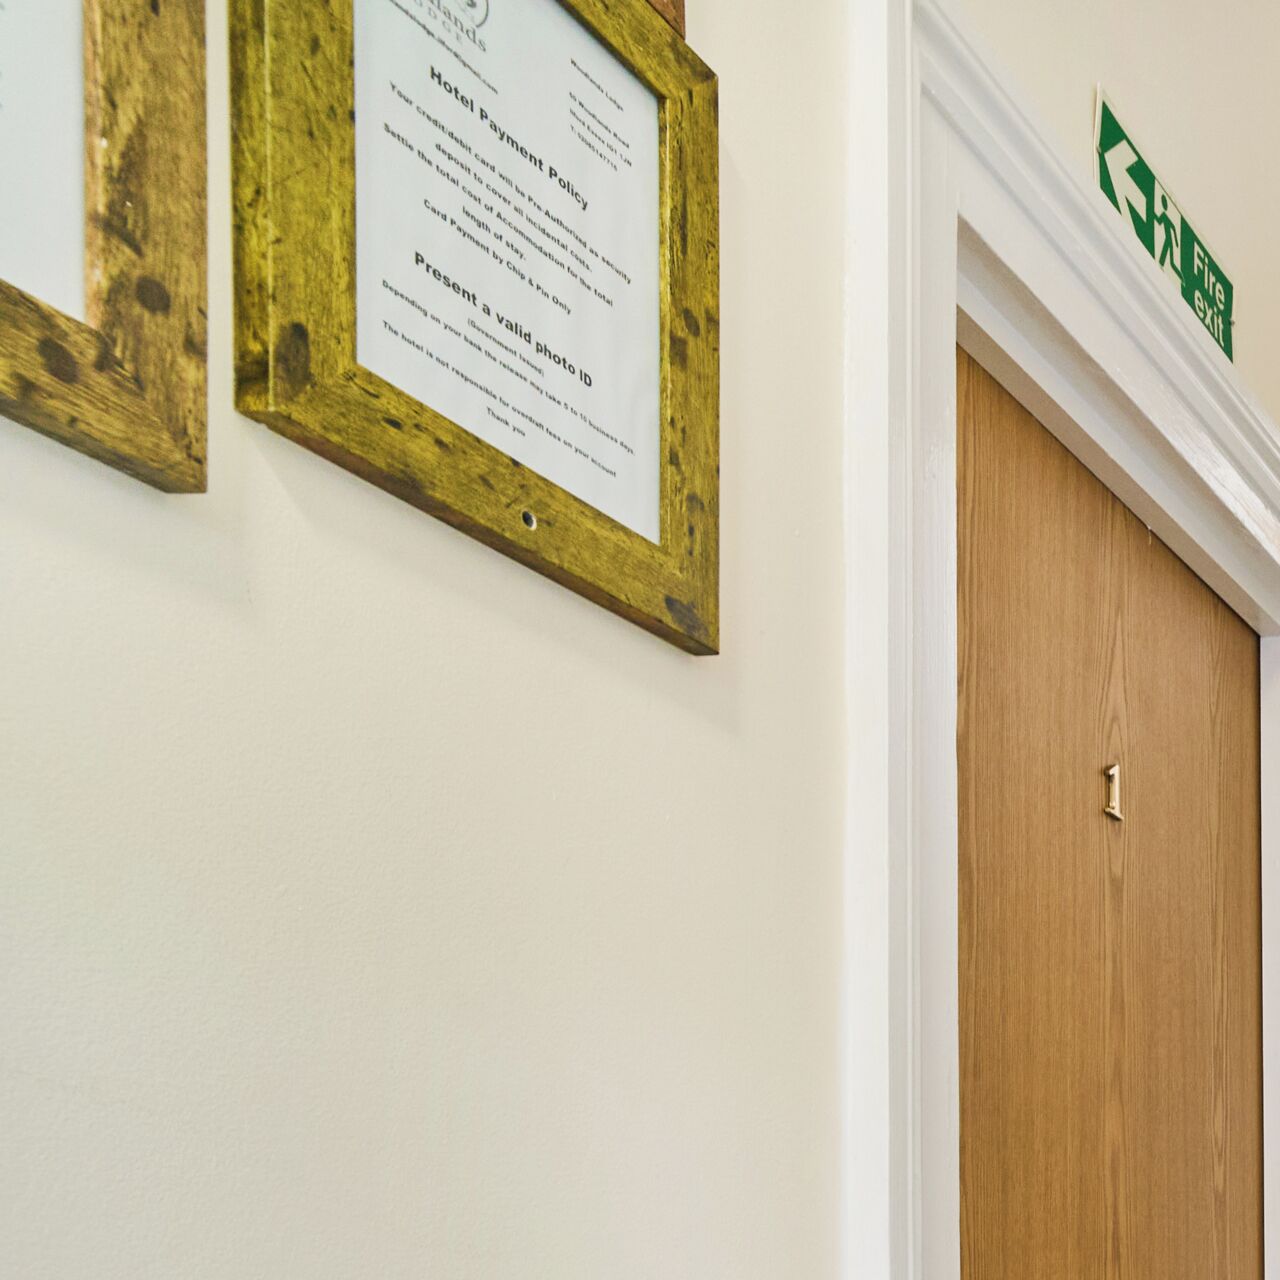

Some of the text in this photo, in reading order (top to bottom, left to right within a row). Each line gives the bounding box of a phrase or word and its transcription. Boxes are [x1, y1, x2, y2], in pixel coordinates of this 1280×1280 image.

[390, 81, 413, 106] Your
[416, 106, 472, 154] credit/debit
[474, 152, 496, 173] card
[498, 171, 513, 188] will
[430, 65, 588, 211] Hotel Payment Policy
[383, 122, 415, 152] Settle
[417, 149, 433, 167] the
[435, 164, 459, 187] total
[461, 185, 482, 206] cost
[483, 203, 494, 214] of
[496, 211, 565, 270] Accommodation
[593, 288, 613, 307] total
[435, 143, 471, 175] deposit
[473, 172, 484, 185] to
[485, 183, 511, 206] cover
[525, 214, 568, 252] incidental
[462, 205, 526, 261] length of stay.
[423, 198, 572, 315] Card Payment by Chip & Pin Only
[1193, 240, 1225, 309] Fire
[382, 279, 428, 317] Depending
[429, 313, 441, 325] on
[443, 322, 462, 337] your
[484, 349, 497, 363] the
[382, 319, 399, 337] The
[401, 333, 424, 353] hotel
[425, 349, 434, 359] is
[435, 356, 450, 370] not
[414, 251, 593, 387] Present a valid photo ID
[1194, 290, 1224, 348] exit
[486, 406, 510, 427] Thank
[1103, 763, 1124, 821] 1
